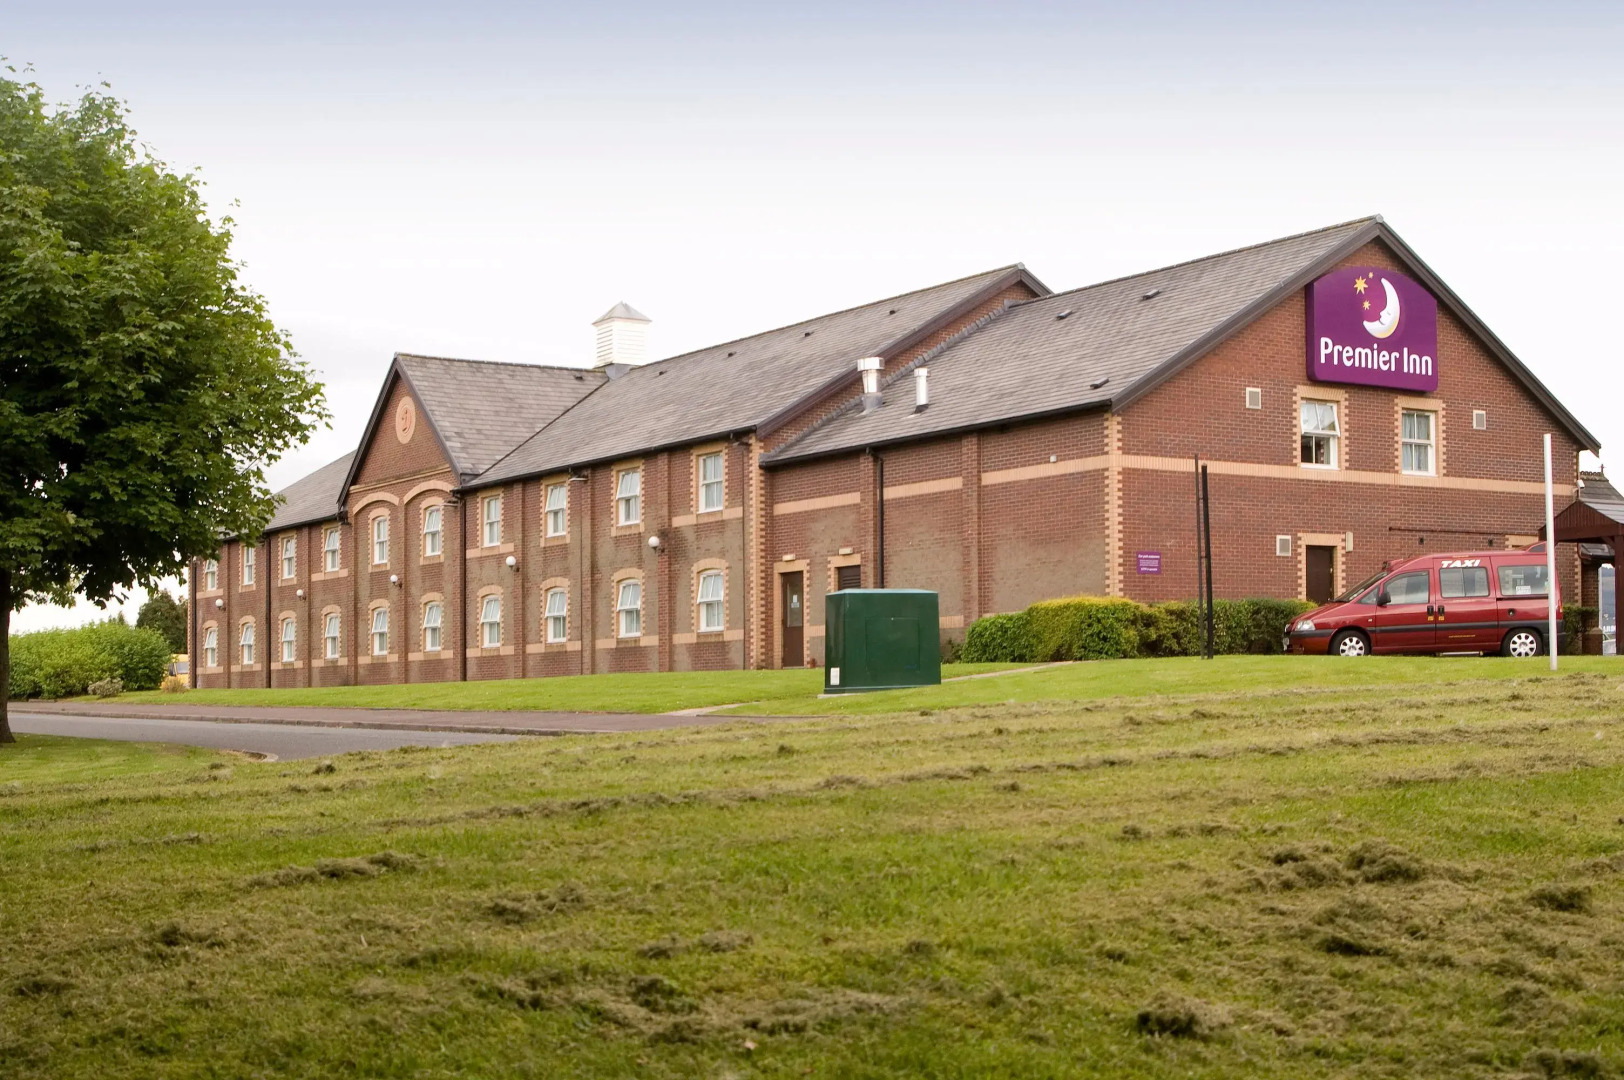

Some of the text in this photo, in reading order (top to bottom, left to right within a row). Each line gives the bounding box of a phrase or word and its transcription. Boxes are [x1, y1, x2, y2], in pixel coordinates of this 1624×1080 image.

[1320, 337, 1432, 376] Premier Inn
[1441, 560, 1481, 568] TAXI
